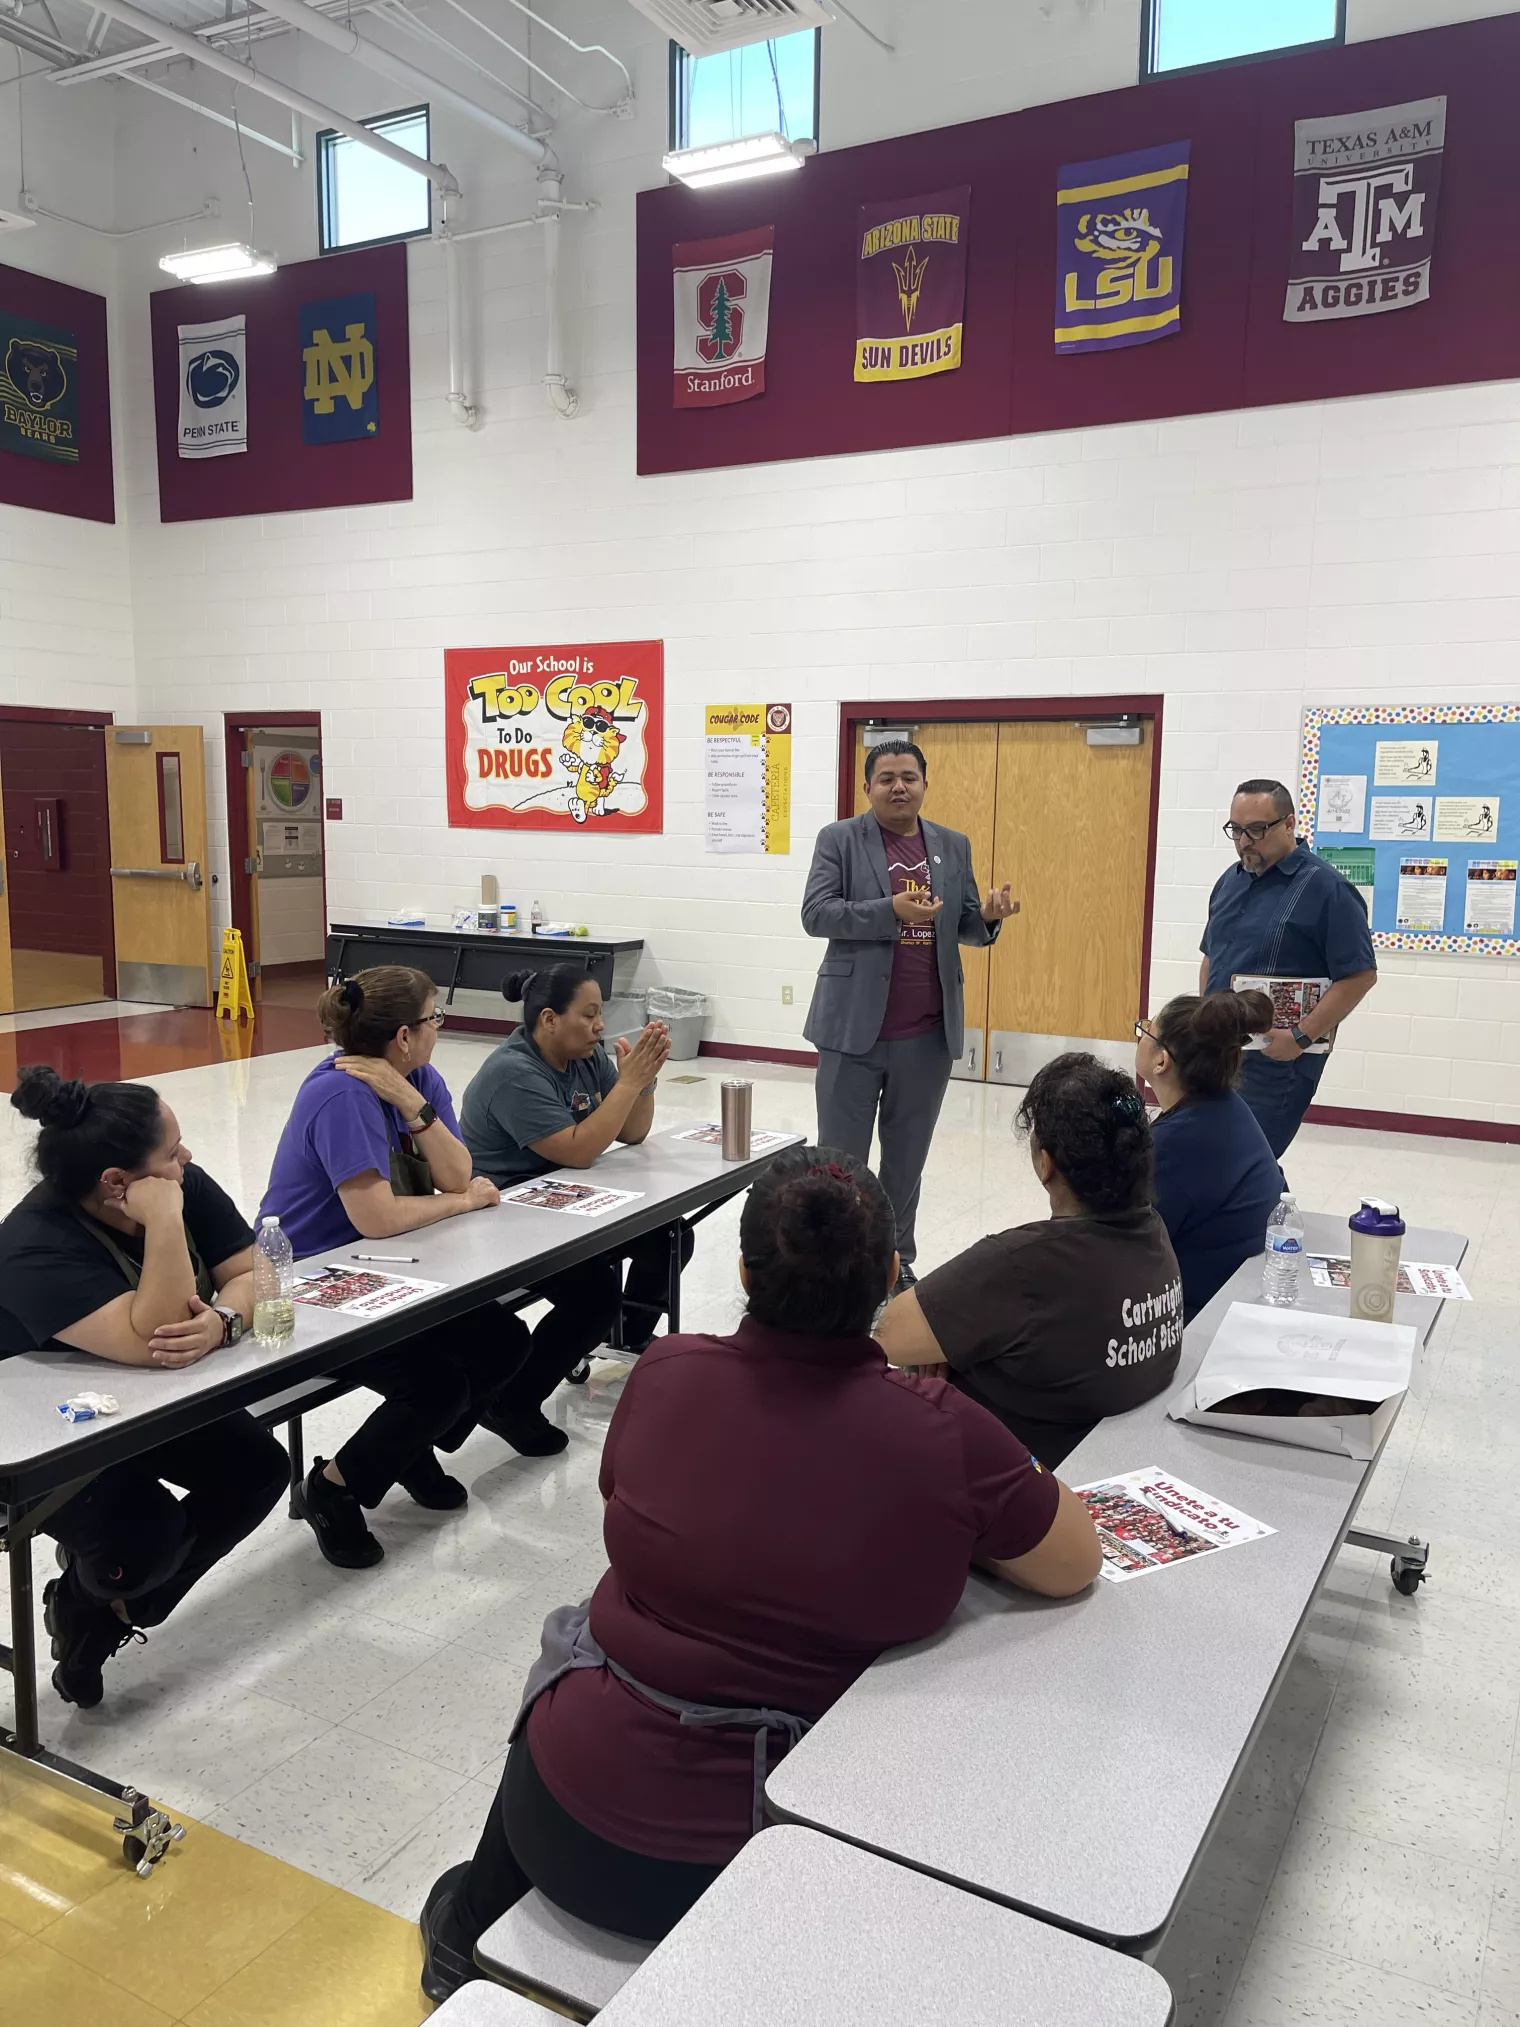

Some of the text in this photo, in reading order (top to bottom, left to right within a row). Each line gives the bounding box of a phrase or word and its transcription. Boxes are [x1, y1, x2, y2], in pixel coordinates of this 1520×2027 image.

[1306, 120, 1433, 155] TEXAS A&M
[1307, 139, 1433, 166] UNIVERSITY
[862, 214, 960, 258] ARIZONA STATE
[1064, 256, 1173, 313] LSU
[1297, 271, 1422, 312] AGGIES
[861, 335, 953, 369] SUN DEVILS
[686, 367, 755, 393] Stanford
[4, 404, 73, 439] BAYLOR
[20, 427, 56, 443] BEARS
[182, 420, 239, 439] PENN STATE
[509, 656, 594, 675] Our School is
[709, 714, 760, 725] COUGAR CODE
[497, 727, 533, 744] To Do
[477, 746, 553, 780] DRUGS
[770, 763, 781, 822] CAFETERIA
[899, 878, 930, 893] The
[912, 928, 936, 939] Lopez
[1105, 1328, 1157, 1368] School
[1144, 1485, 1218, 1530] Sindicato
[1218, 1517, 1240, 1530] tu
